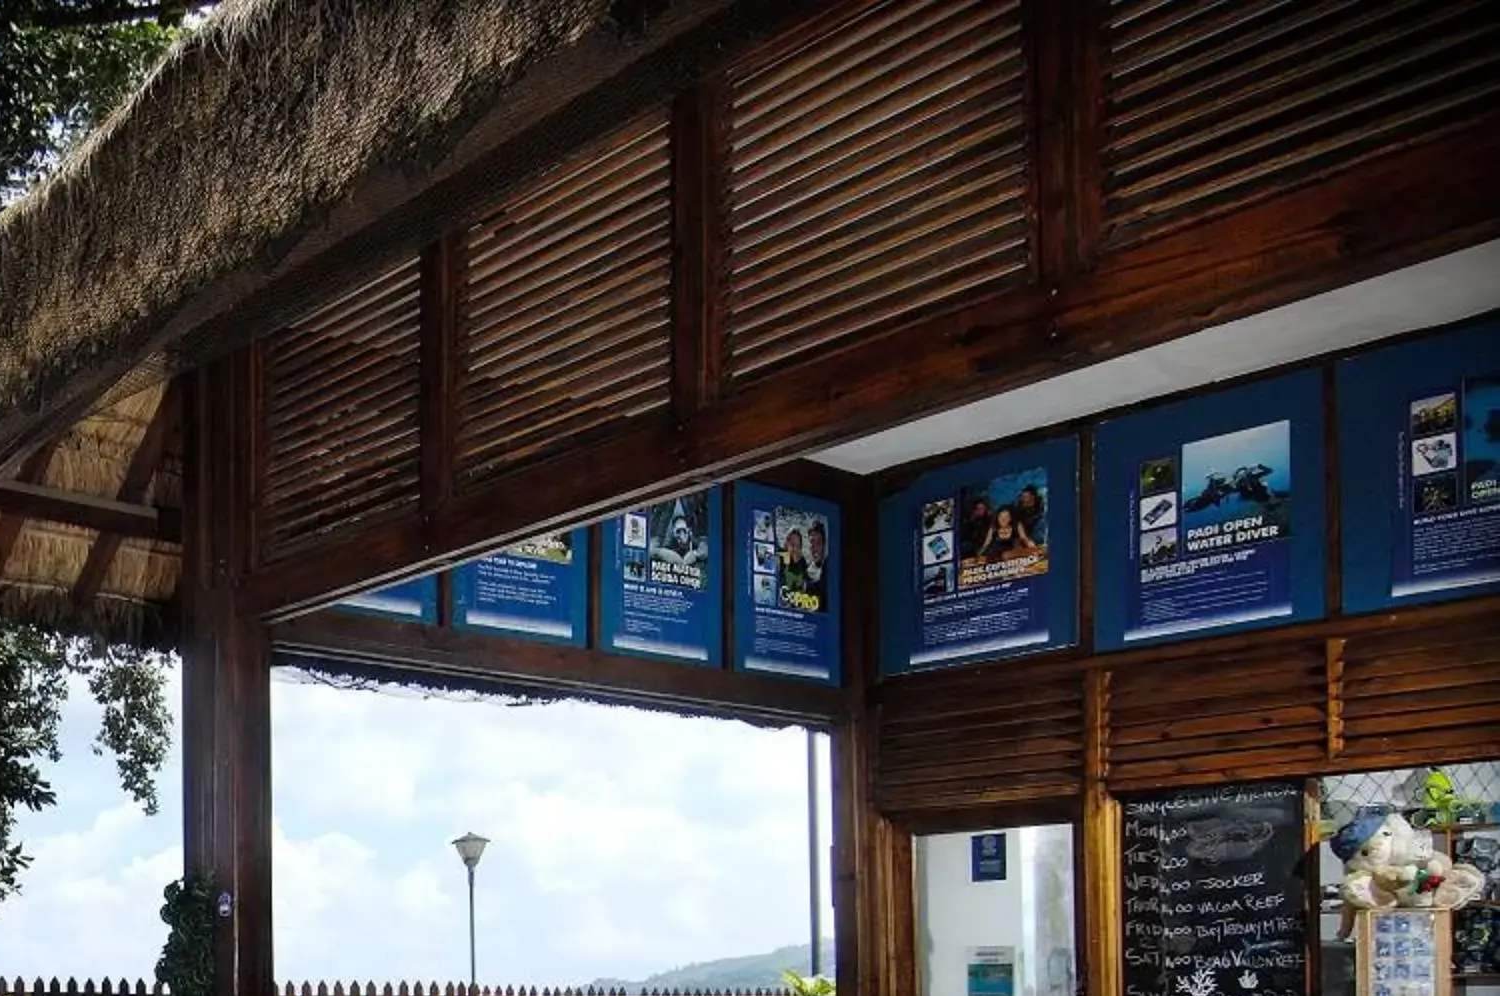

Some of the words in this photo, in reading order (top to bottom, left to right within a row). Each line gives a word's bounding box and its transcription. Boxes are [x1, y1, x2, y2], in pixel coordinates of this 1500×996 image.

[1187, 524, 1219, 540] PADI
[1224, 515, 1262, 533] OPEN
[1187, 533, 1232, 551] WATER
[1235, 525, 1279, 543] DIVER
[1243, 893, 1285, 911] REEF
